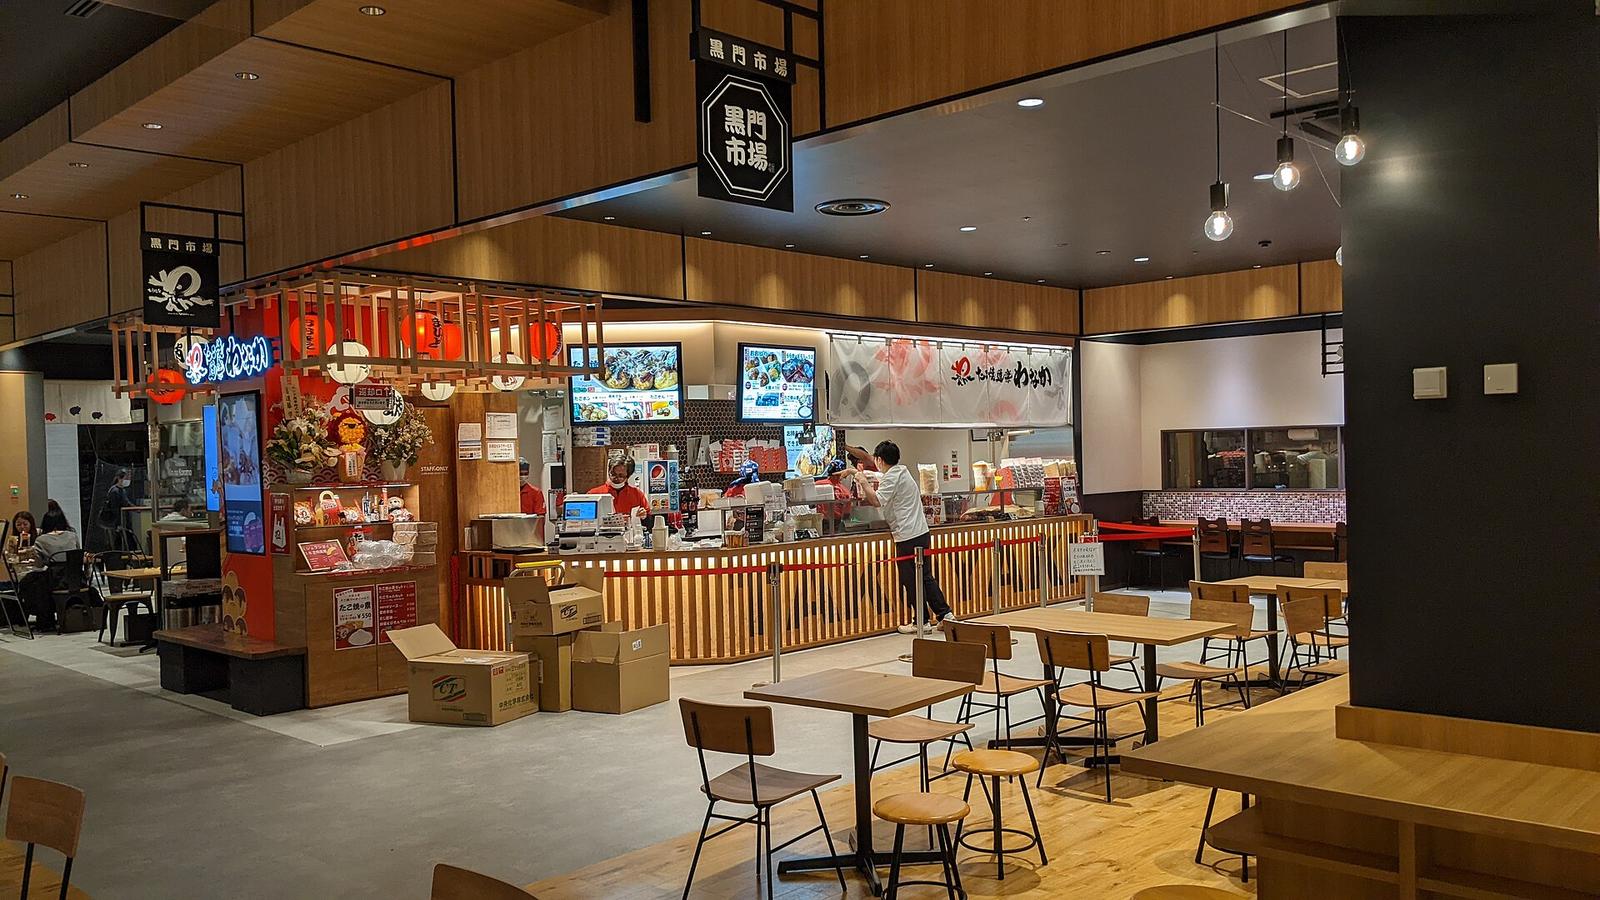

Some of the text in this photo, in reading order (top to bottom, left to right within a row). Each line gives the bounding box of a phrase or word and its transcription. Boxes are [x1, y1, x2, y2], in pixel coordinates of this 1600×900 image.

[709, 38, 788, 77] 黒門市場
[724, 104, 767, 141] 黒門
[725, 136, 768, 172] 市場
[150, 237, 213, 254] 黒門市場
[438, 682, 458, 695] CT
